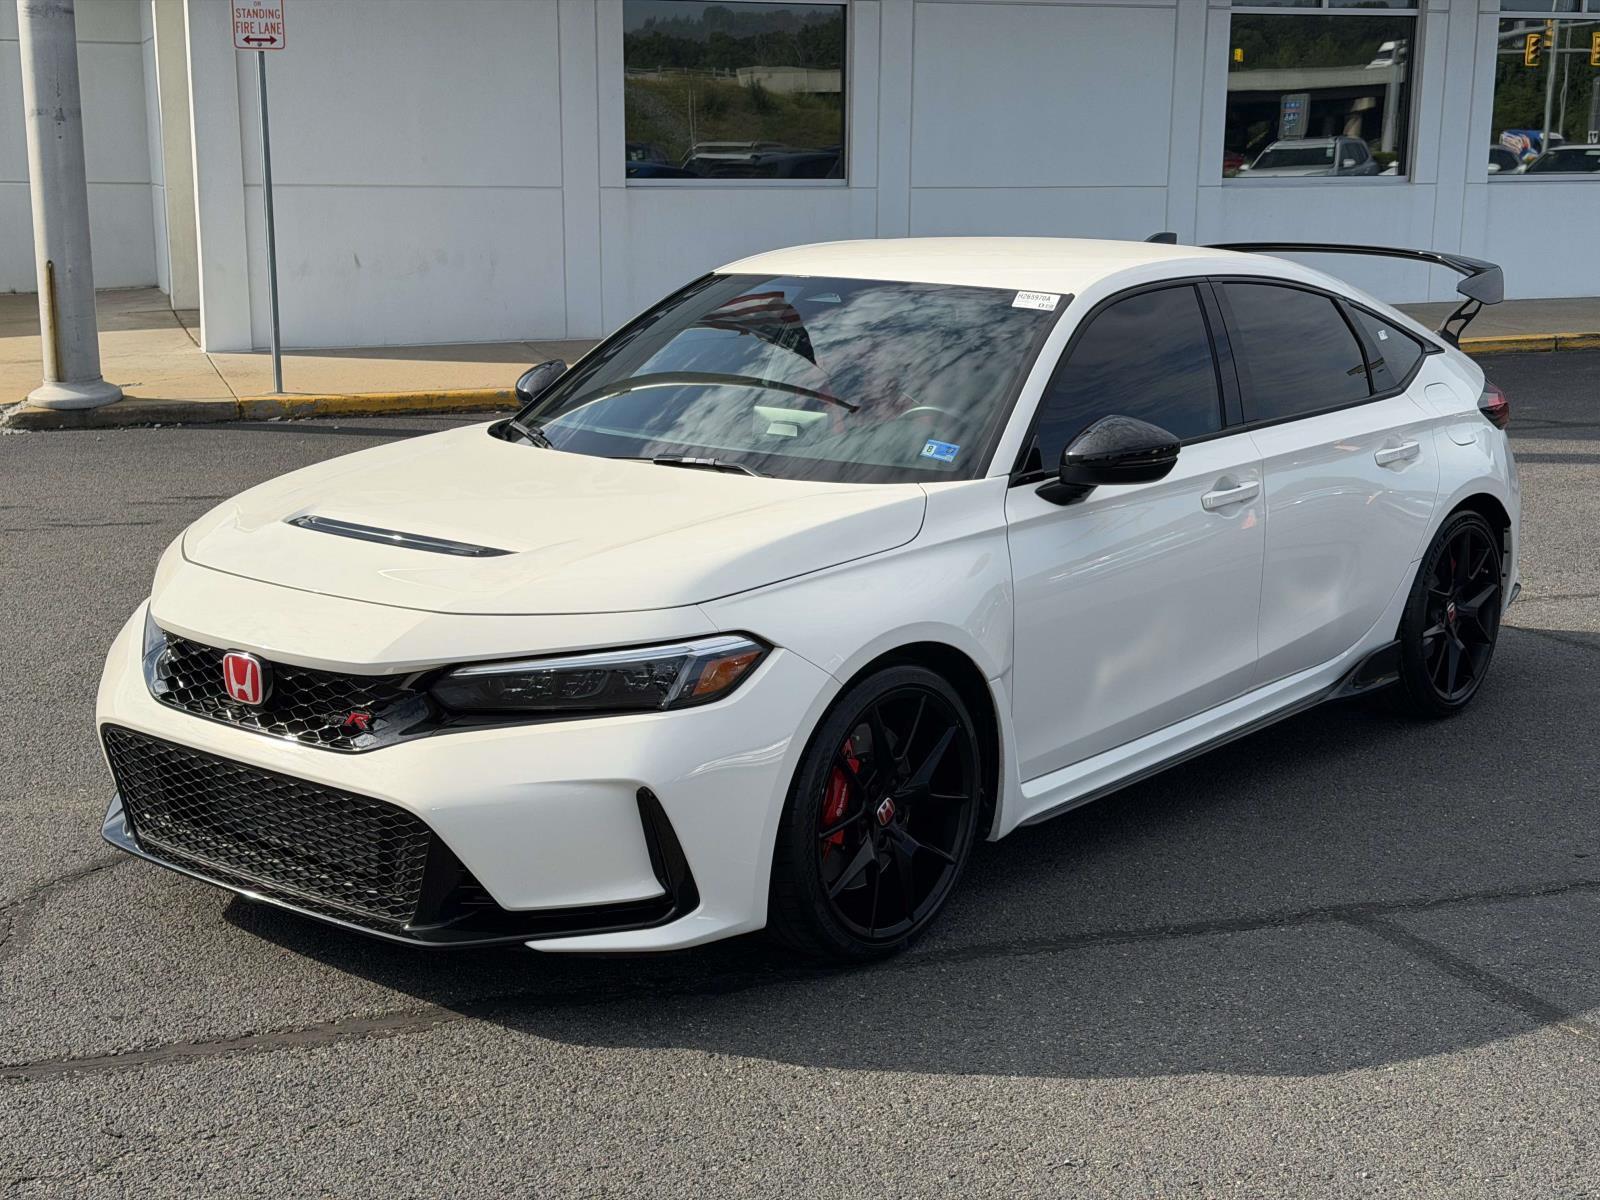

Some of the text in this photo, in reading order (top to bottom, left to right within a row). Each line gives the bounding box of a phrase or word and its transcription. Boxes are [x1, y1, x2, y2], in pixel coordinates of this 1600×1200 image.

[235, 7, 281, 19] STANDING
[235, 21, 282, 35] FIRE LANE
